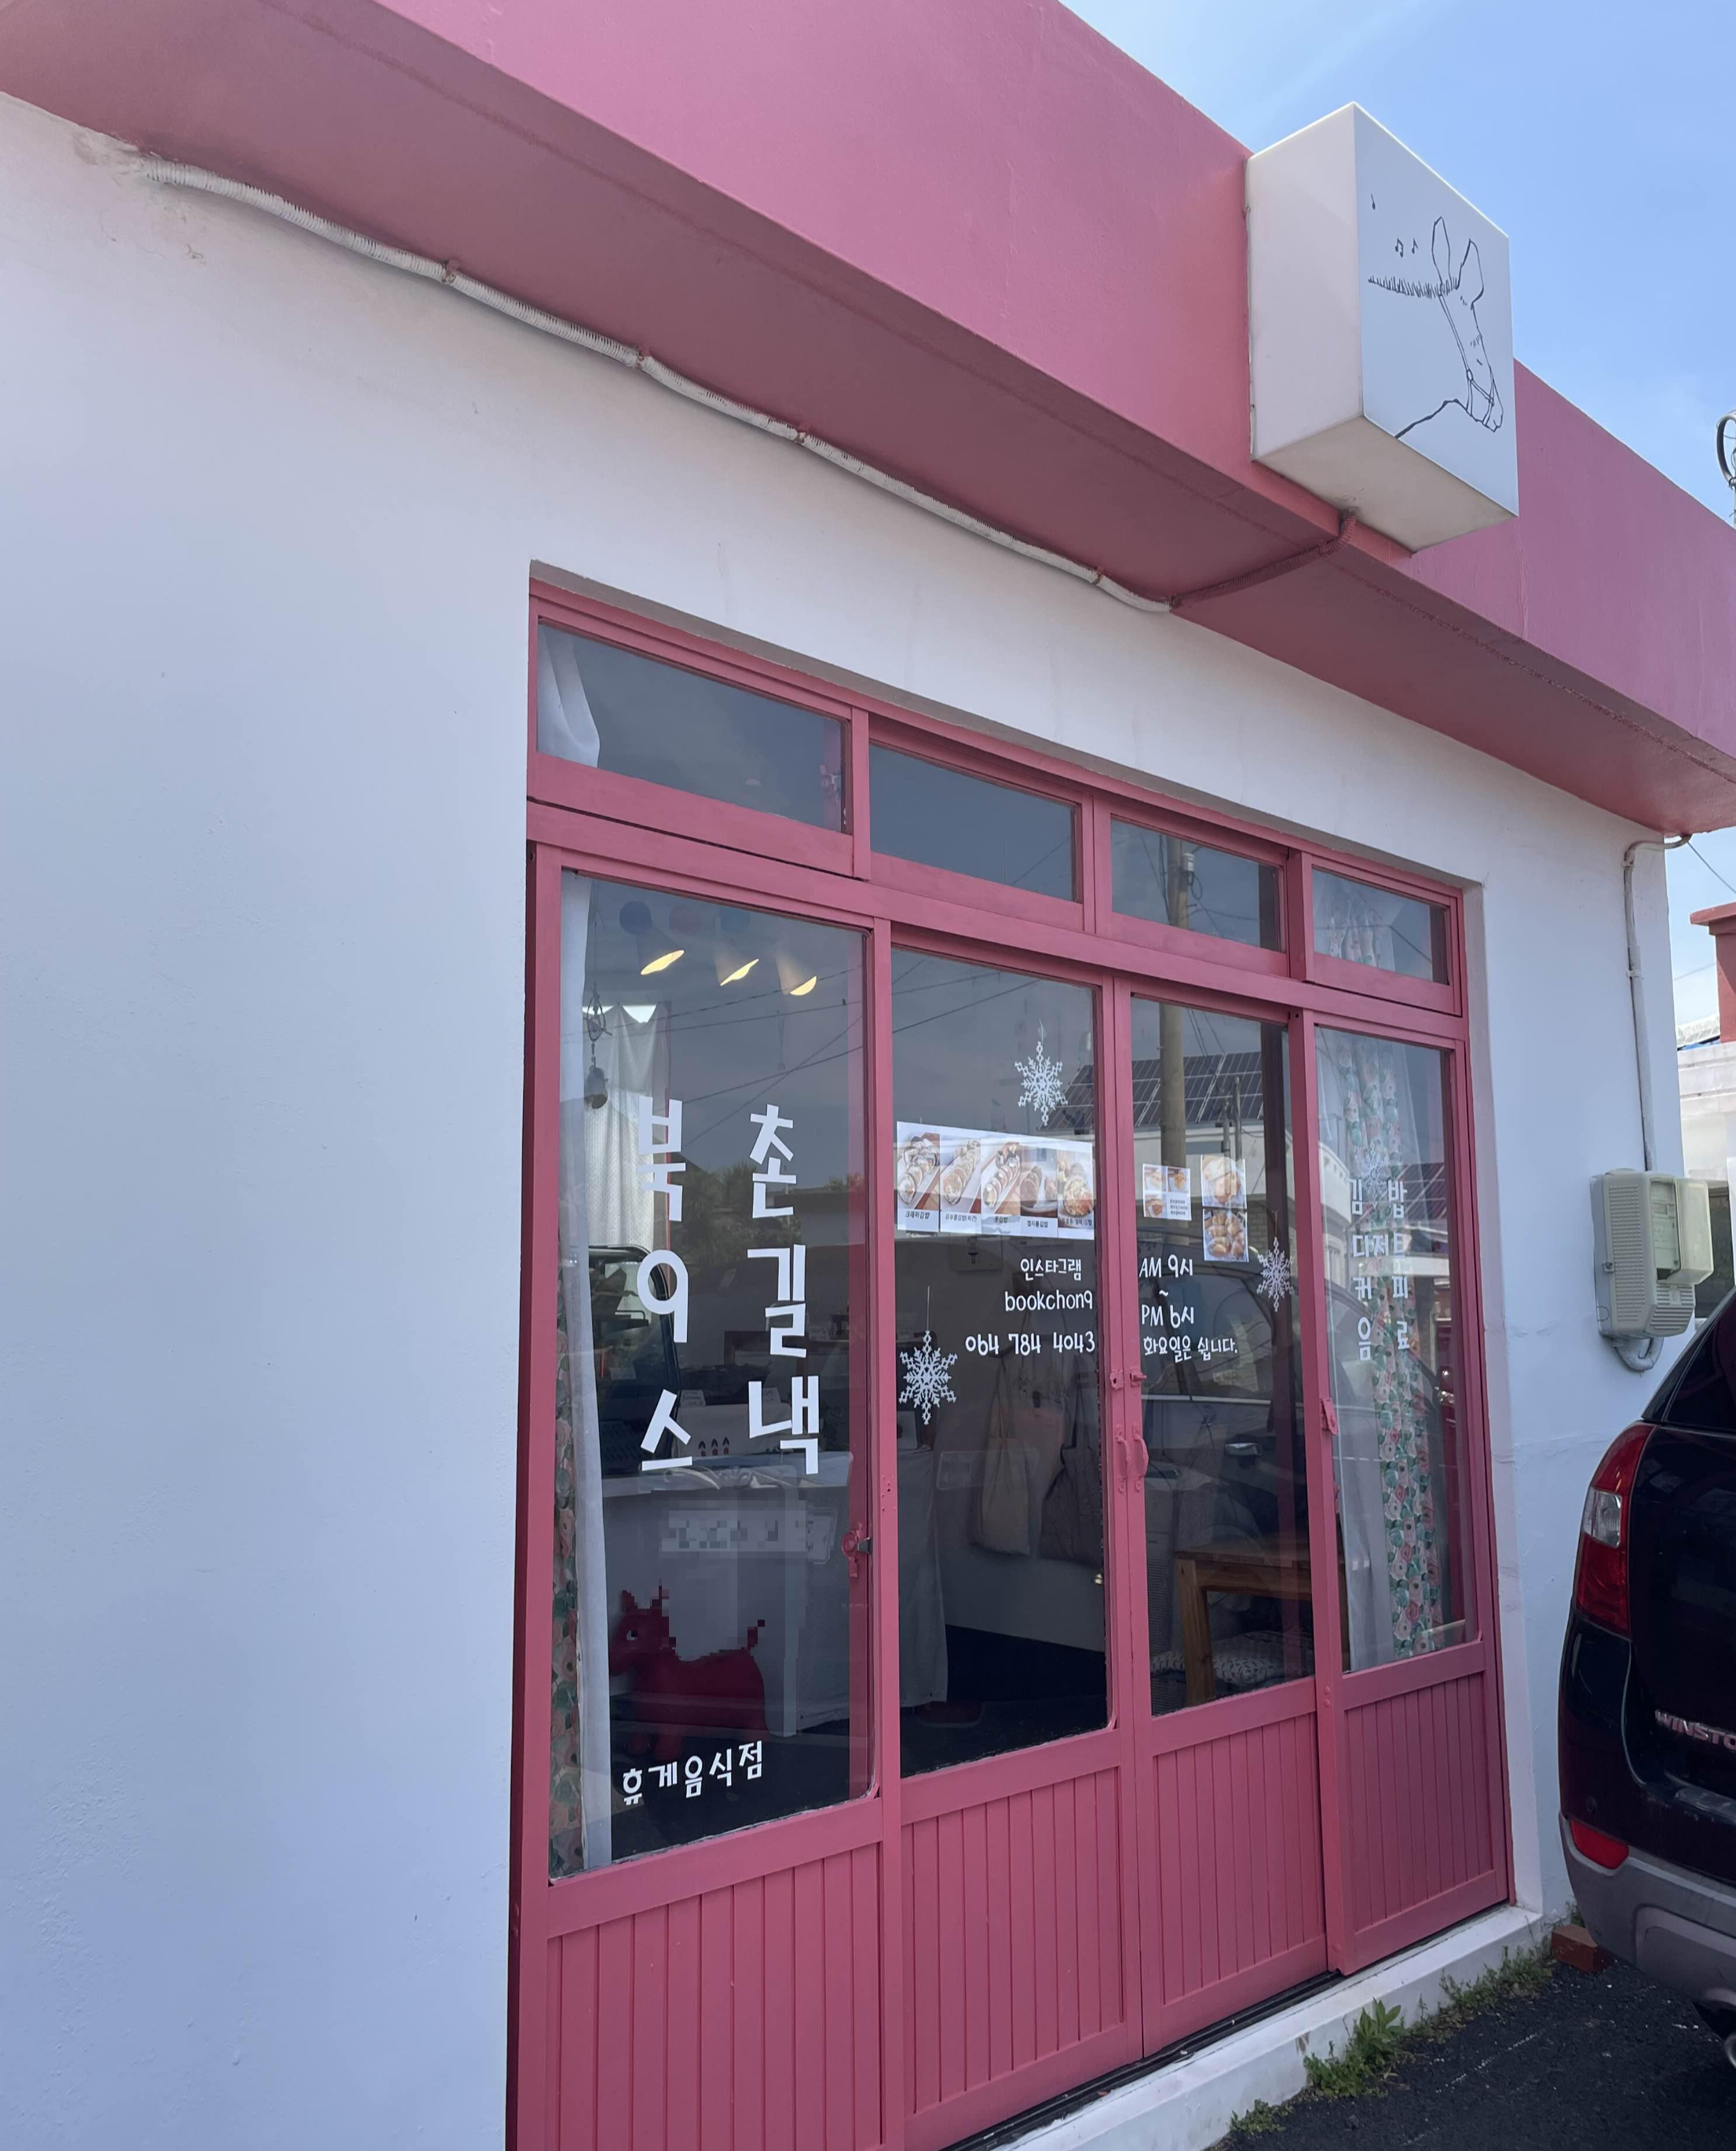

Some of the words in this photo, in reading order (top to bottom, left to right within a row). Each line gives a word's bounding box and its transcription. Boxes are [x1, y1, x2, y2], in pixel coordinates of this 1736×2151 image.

[1349, 1179, 1407, 1218] 김밥
[1021, 1258, 1082, 1281] 인스타그램
[1139, 1257, 1161, 1278] AM
[1168, 1254, 1193, 1278] 9시
[1353, 1276, 1408, 1300] 커피
[1142, 1304, 1163, 1326] PM
[1170, 1304, 1194, 1328] 6시
[965, 1333, 1000, 1356] 064
[1008, 1333, 1041, 1355] 784
[1053, 1331, 1095, 1353] 4043
[1143, 1335, 1192, 1363] 화요일은
[1197, 1337, 1237, 1361] 쉽니다.
[1358, 1317, 1409, 1361] 음료
[623, 1740, 762, 1805] 휴게음식점
